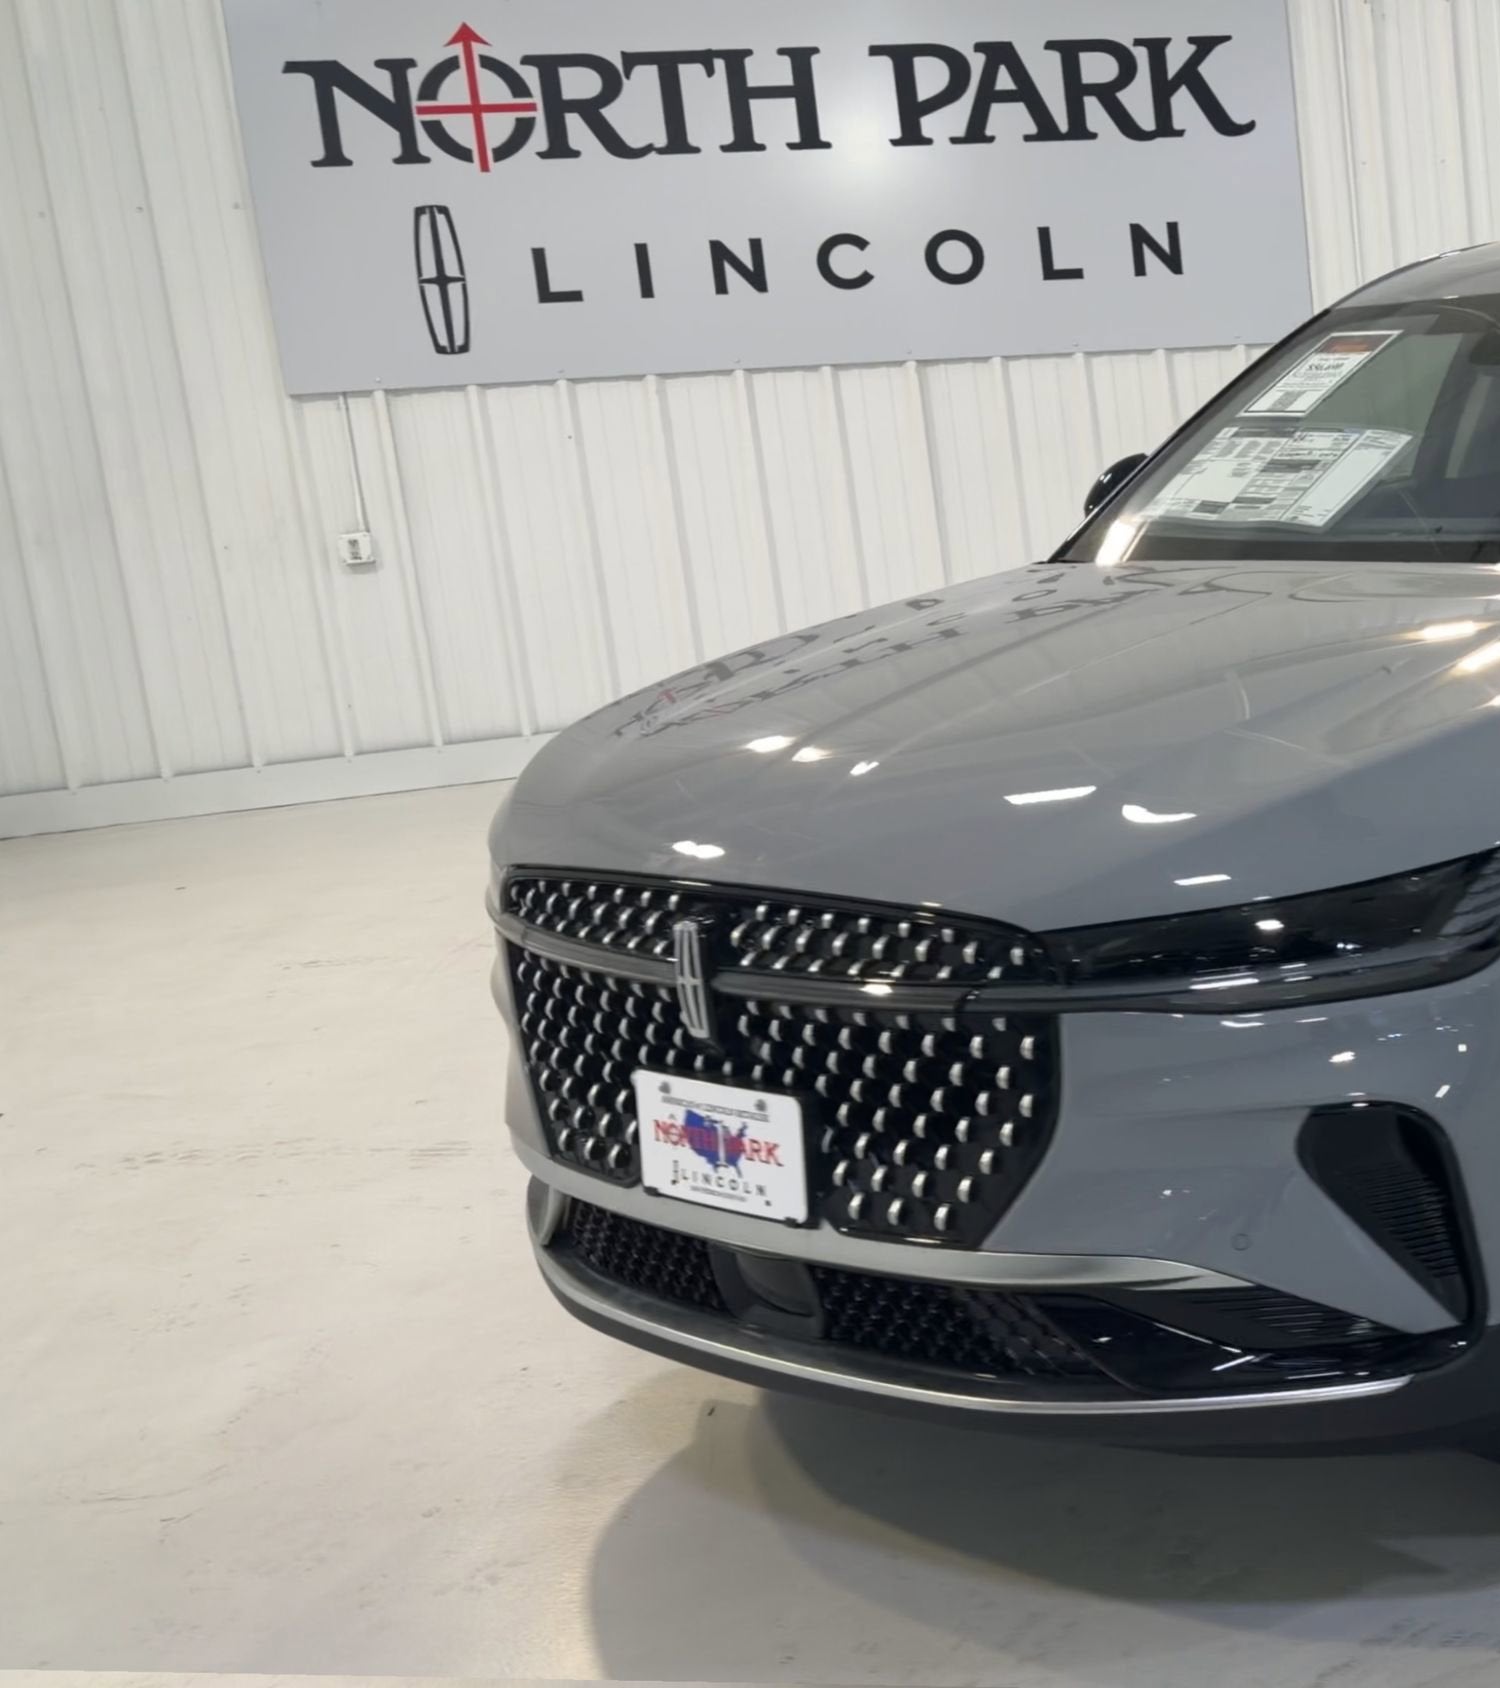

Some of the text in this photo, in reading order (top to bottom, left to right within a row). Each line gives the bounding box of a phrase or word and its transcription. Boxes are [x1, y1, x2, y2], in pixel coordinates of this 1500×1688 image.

[282, 34, 1257, 170] NORTH PARK
[531, 221, 1184, 304] LINCOLN
[681, 1168, 768, 1197] LINCOLN
